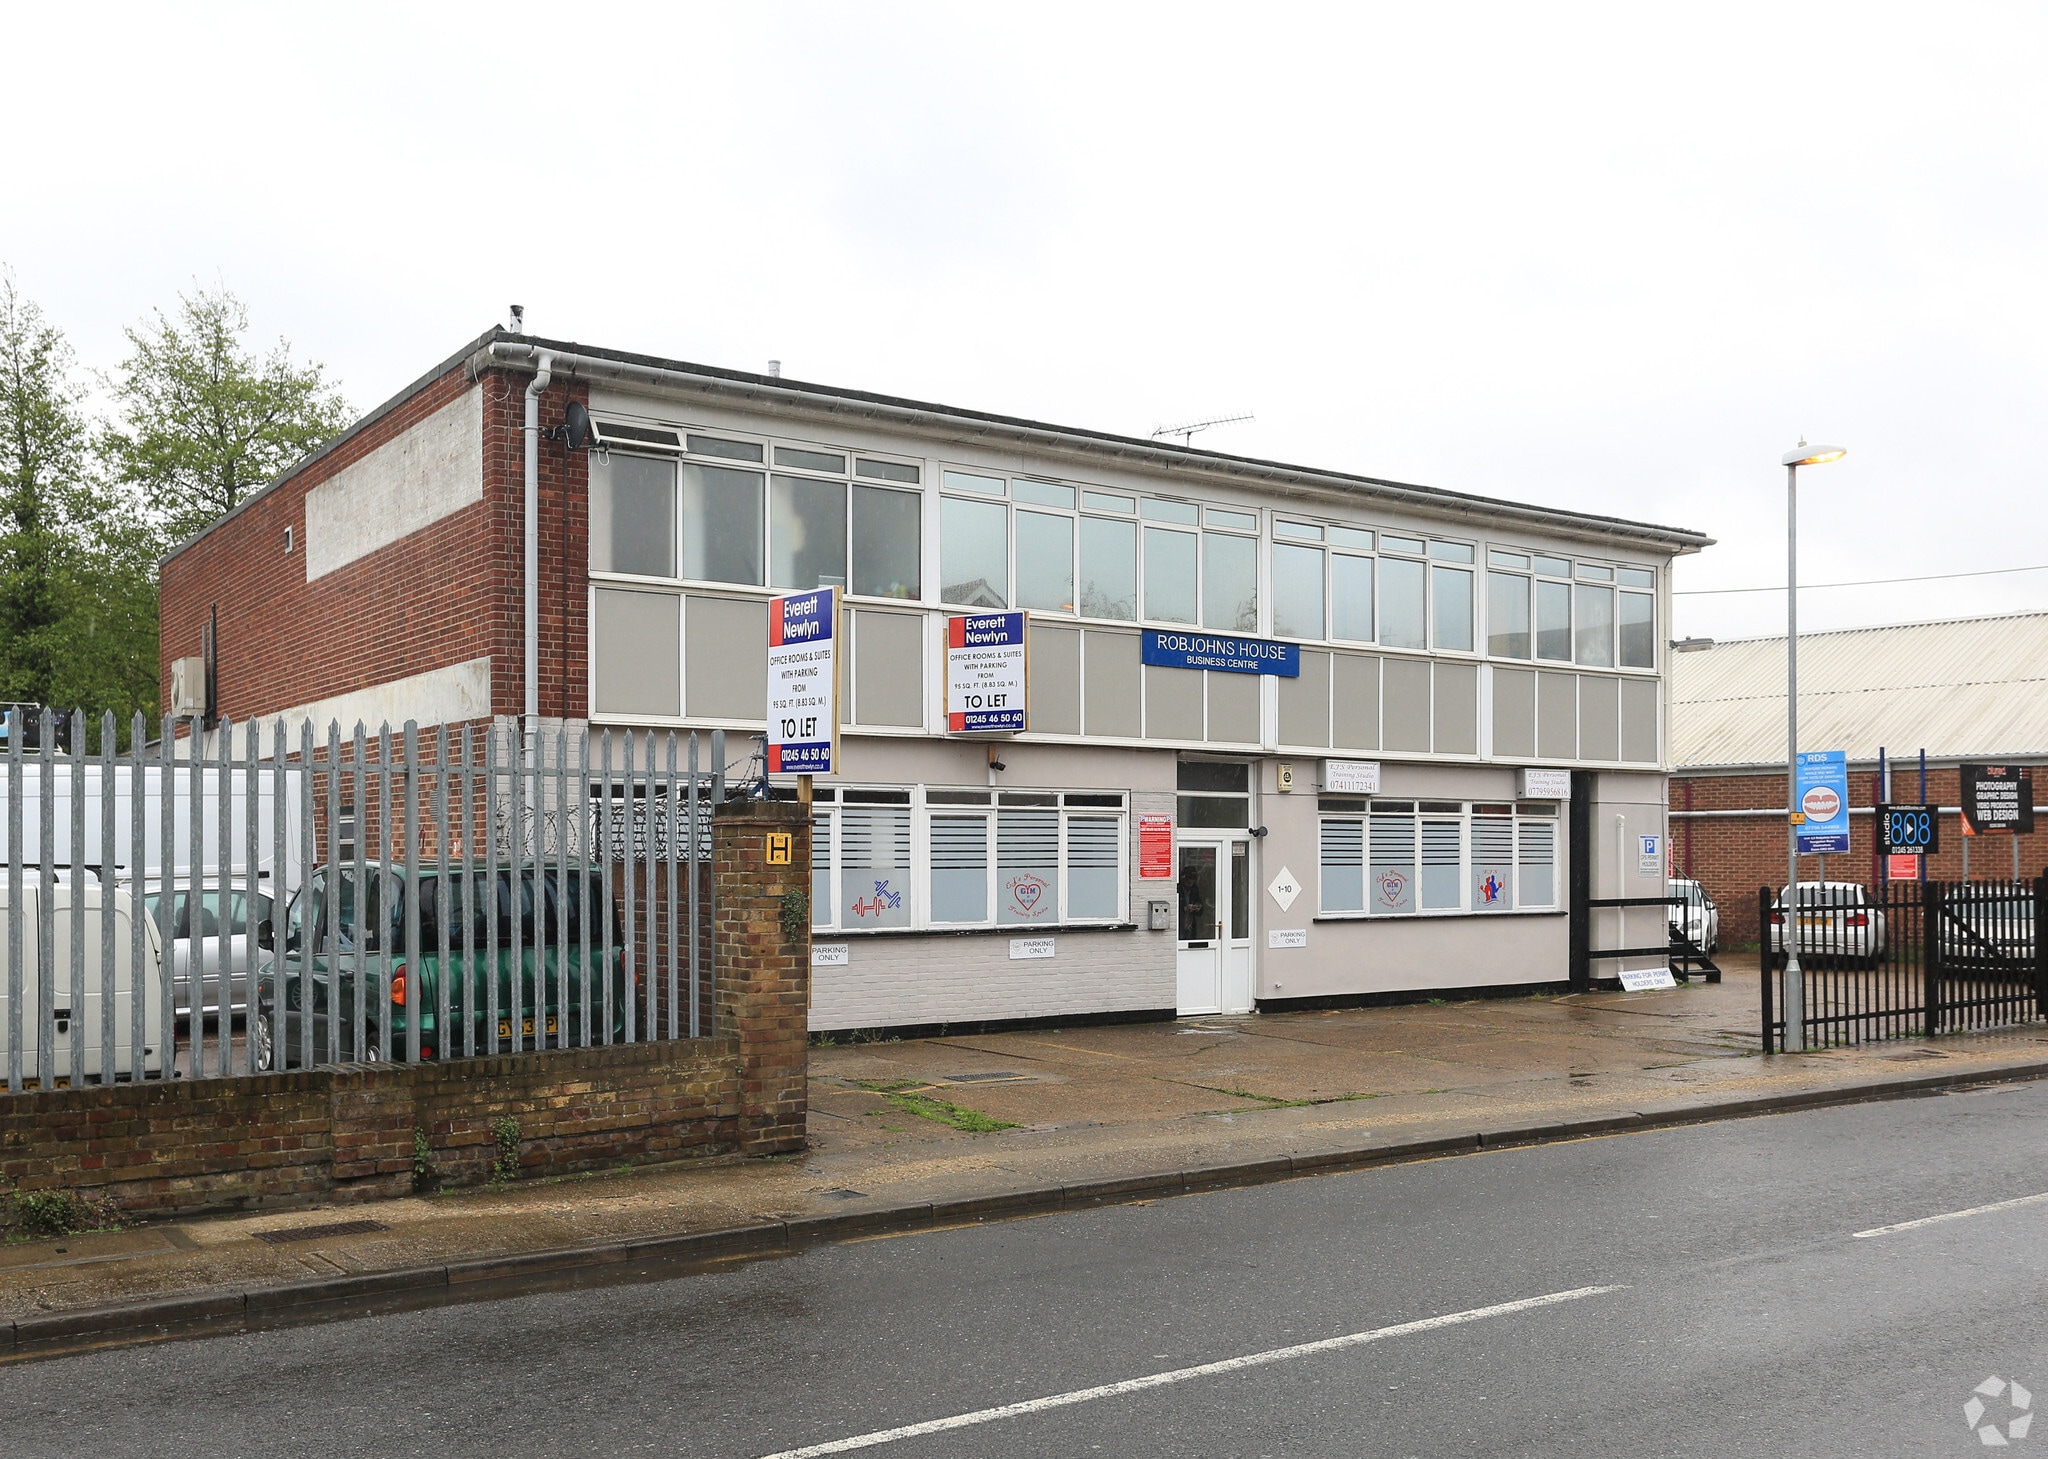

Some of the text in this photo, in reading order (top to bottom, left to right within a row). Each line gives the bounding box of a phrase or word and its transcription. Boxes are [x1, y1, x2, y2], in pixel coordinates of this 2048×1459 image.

[784, 596, 818, 618] Everett
[783, 619, 819, 639] Newlyn
[966, 616, 1005, 630] Everett
[966, 631, 1008, 644] Newlyn
[1157, 634, 1286, 660] ROBJOHNS HOUSE
[770, 649, 831, 666] OFFICE ROOMS & SUITES
[972, 652, 996, 660] ROOMS
[1187, 655, 1259, 669] BUSINESS CENTRE
[781, 666, 818, 679] WITH PARKING
[792, 684, 806, 693] FROM
[773, 700, 779, 709] 95
[964, 694, 1007, 708] TO LET
[965, 713, 1023, 724] 01245 46 50 60
[781, 717, 817, 738] TO LET
[781, 748, 830, 761] 01245 46 50 60
[1808, 754, 1827, 762] RDS
[1330, 781, 1376, 791] 07411172341
[1976, 781, 2017, 790] PHOTOGRAPHY
[1976, 792, 2018, 800] GRAPHIC DESIGN
[1976, 810, 2019, 821] WEB DESIGN
[1891, 813, 1931, 844] 808
[771, 836, 788, 861] H
[1646, 841, 1653, 852] P
[1892, 846, 1906, 854] 01245
[1278, 885, 1292, 893] 1-10
[812, 946, 847, 954] PARKING
